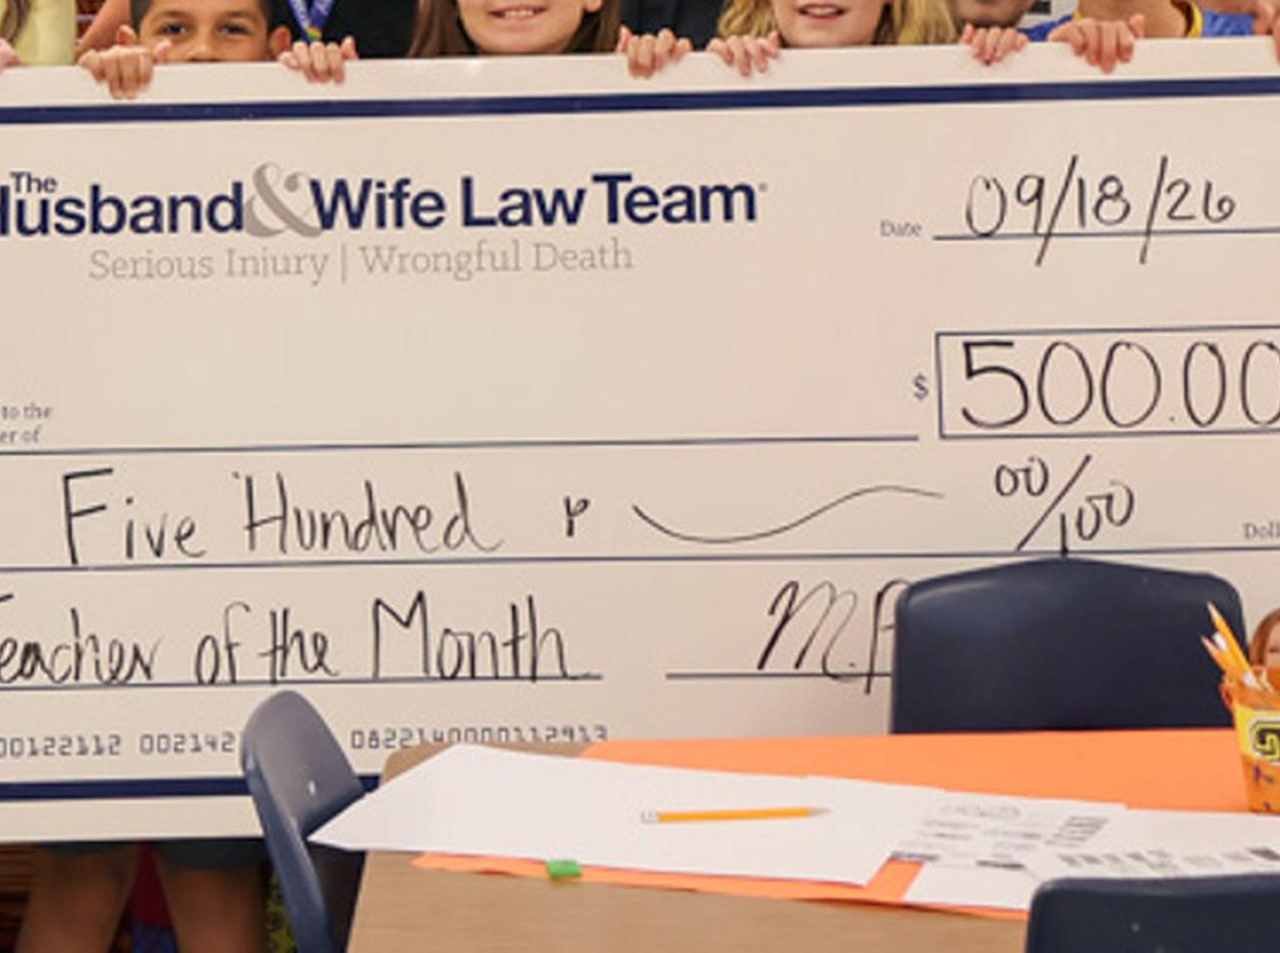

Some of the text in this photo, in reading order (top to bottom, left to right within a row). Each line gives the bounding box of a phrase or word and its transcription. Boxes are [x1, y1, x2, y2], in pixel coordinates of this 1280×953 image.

[10, 171, 58, 195] The
[245, 162, 323, 238] &
[309, 176, 447, 232] Wife
[462, 175, 586, 228] Law
[592, 172, 758, 223] Team
[879, 219, 923, 238] Date
[964, 153, 1236, 267] 09/18/26
[88, 238, 634, 287] Serious Injury Wrongful Death
[912, 372, 930, 402] $
[1, 403, 20, 422] to
[23, 402, 54, 420] the
[21, 425, 42, 444] of
[61, 468, 208, 566] Five
[242, 470, 505, 554] Hundred
[194, 600, 252, 685] of
[257, 607, 339, 686] the
[371, 590, 586, 683] Month
